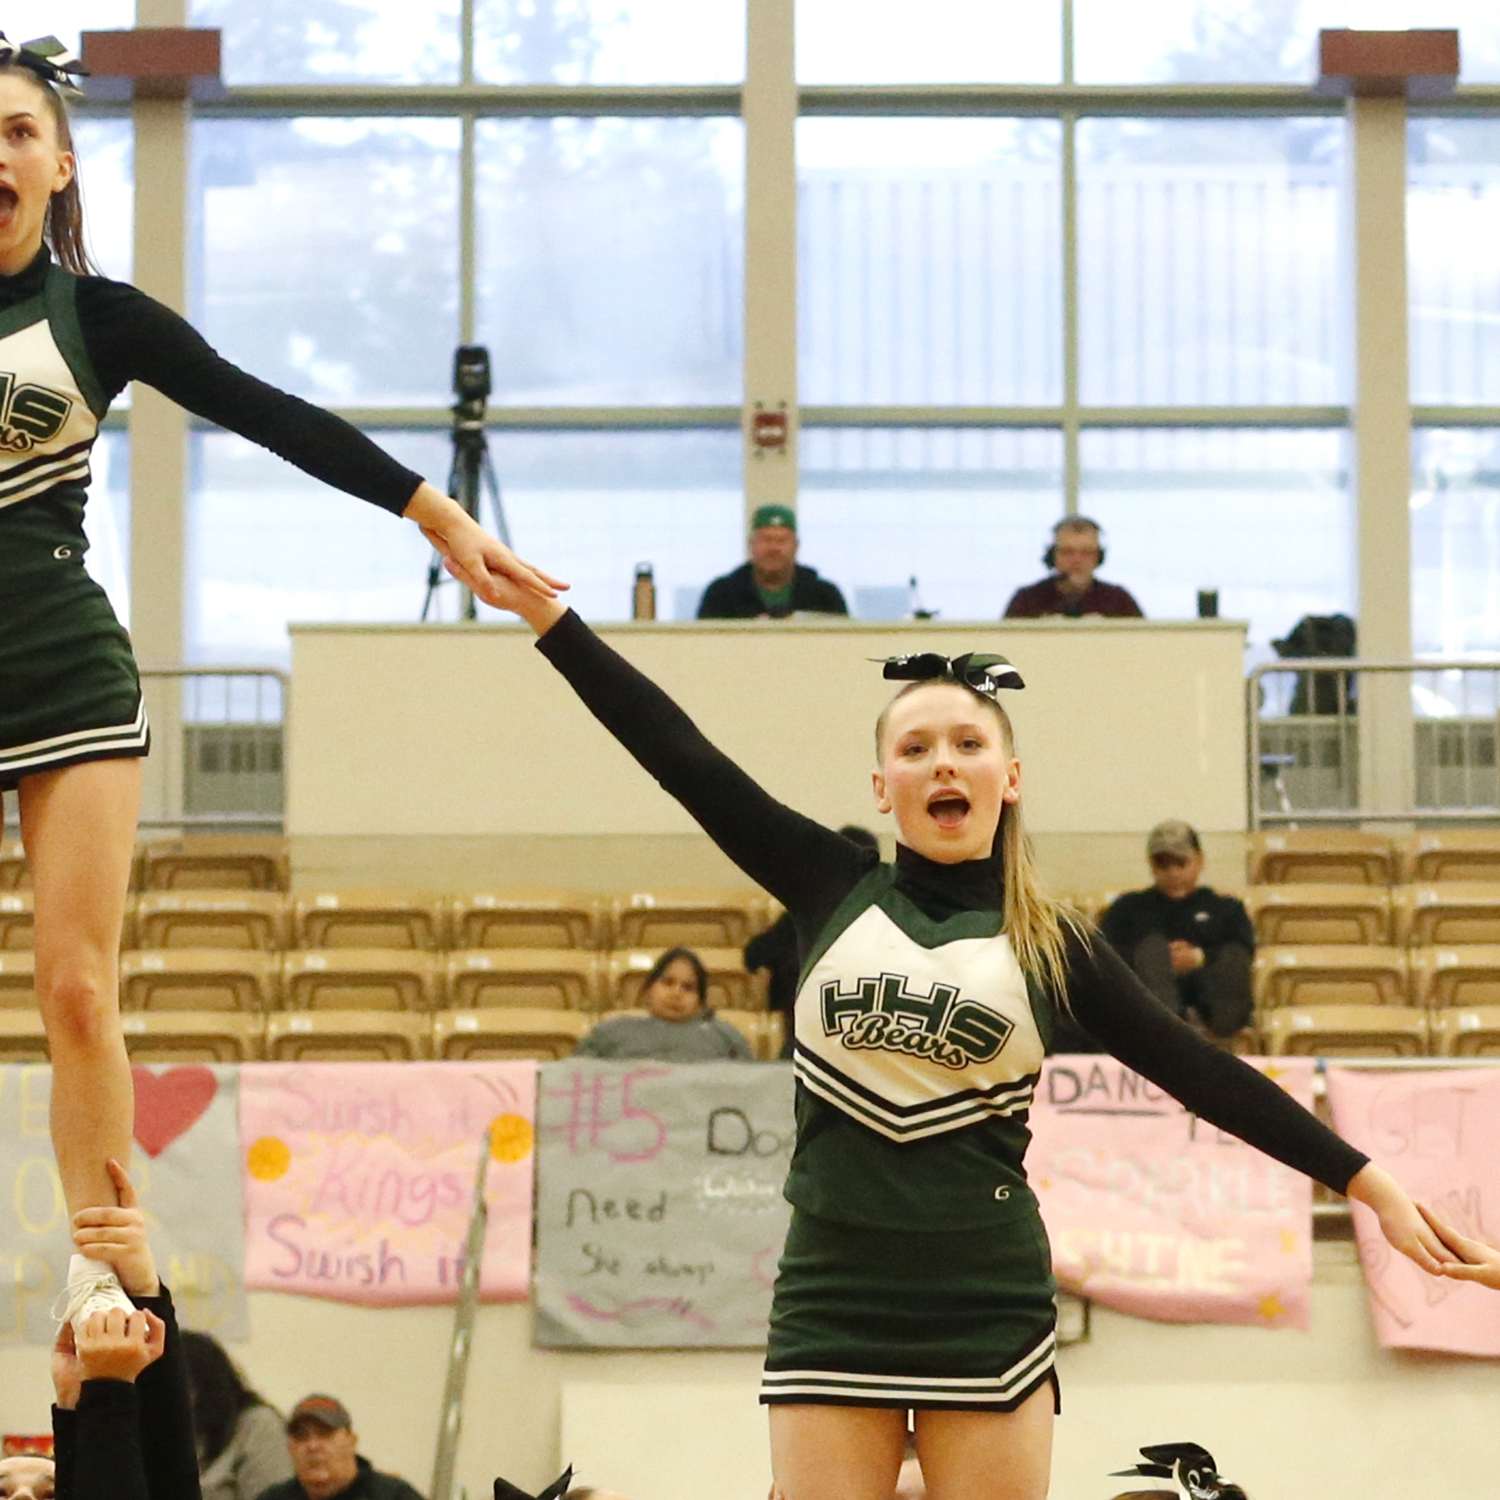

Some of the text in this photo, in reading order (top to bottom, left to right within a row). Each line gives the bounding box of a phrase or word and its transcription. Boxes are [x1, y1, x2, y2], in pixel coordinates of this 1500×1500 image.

[820, 972, 1015, 1063] HHS
[843, 1012, 968, 1070] Bears
[548, 1068, 673, 1164] #5
[1049, 1062, 1170, 1106] DANC
